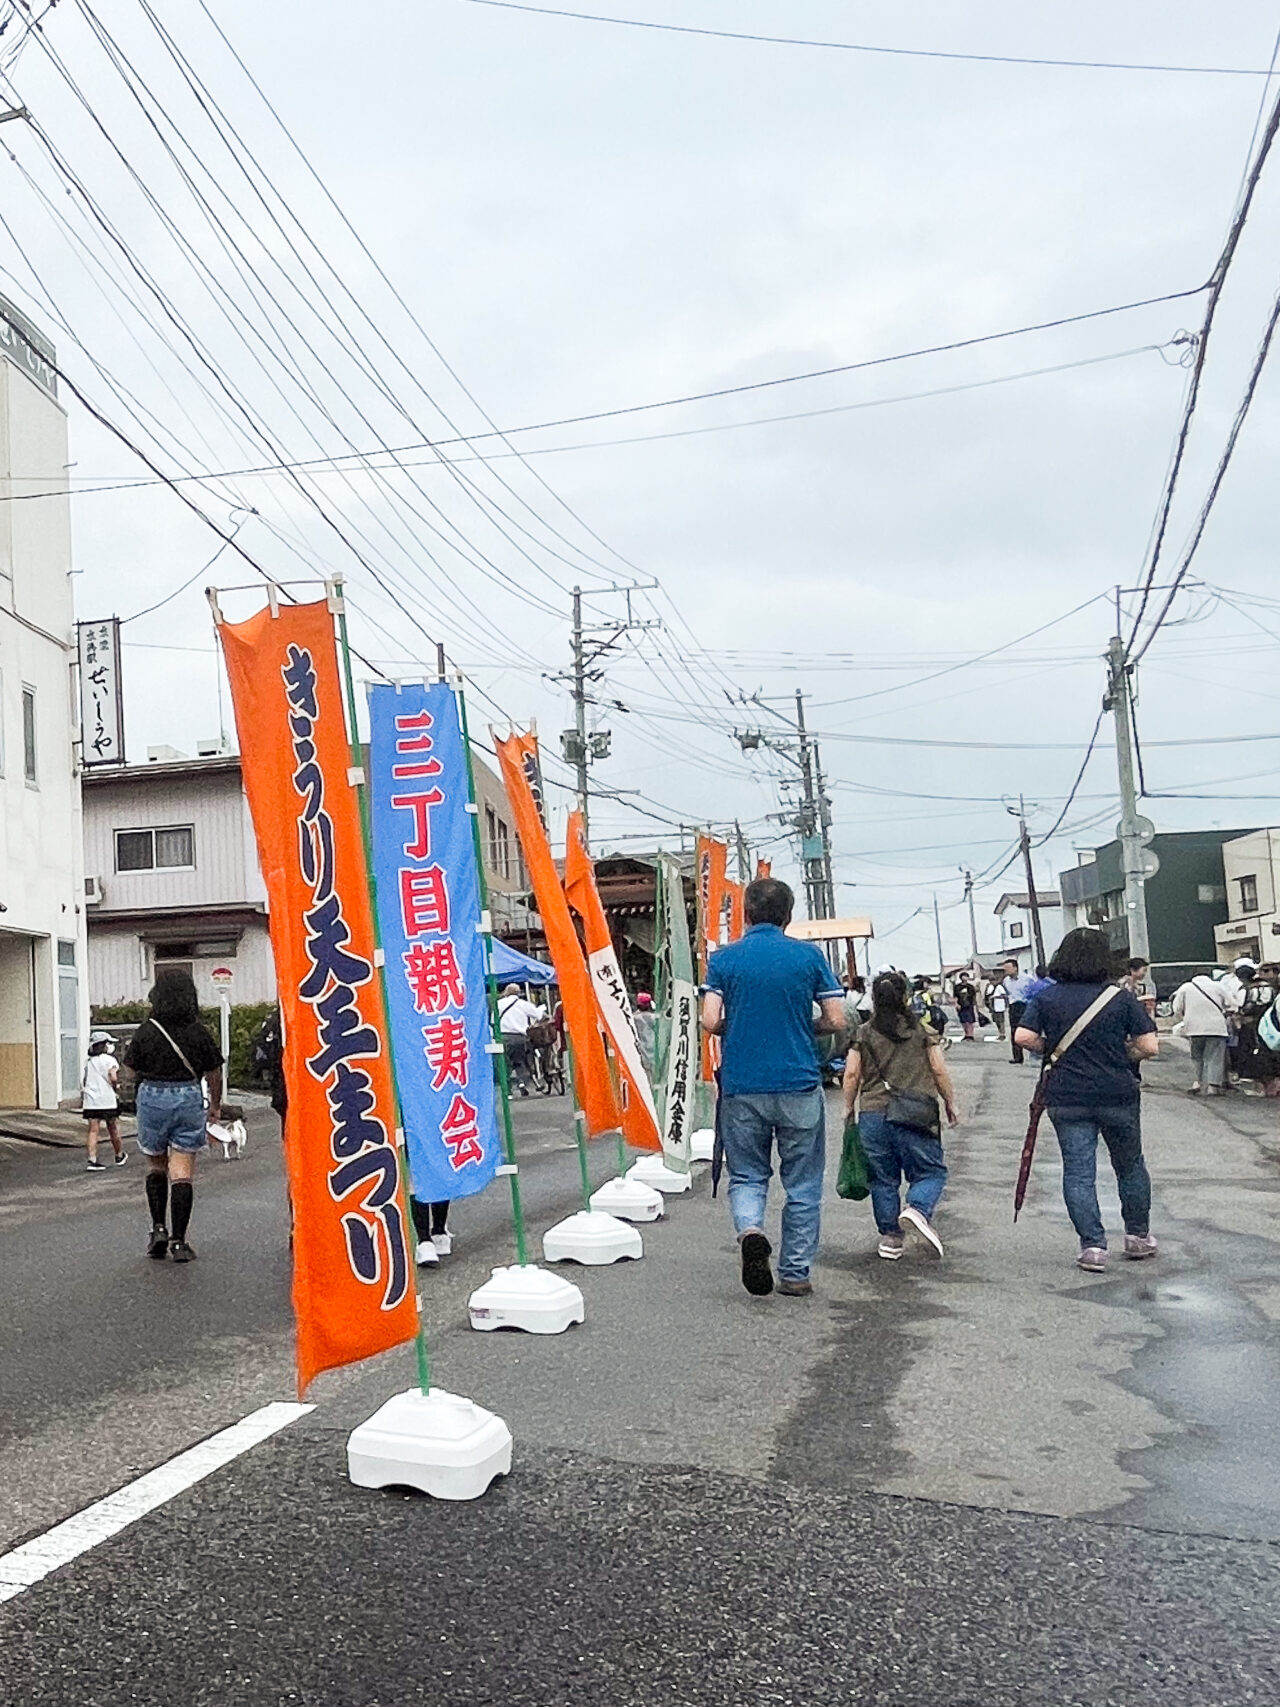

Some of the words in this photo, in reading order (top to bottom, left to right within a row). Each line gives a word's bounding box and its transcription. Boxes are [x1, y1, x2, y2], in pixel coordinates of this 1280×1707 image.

[281, 643, 408, 1310] きうり天王まつり
[392, 708, 485, 1172] 三丁目親寿会
